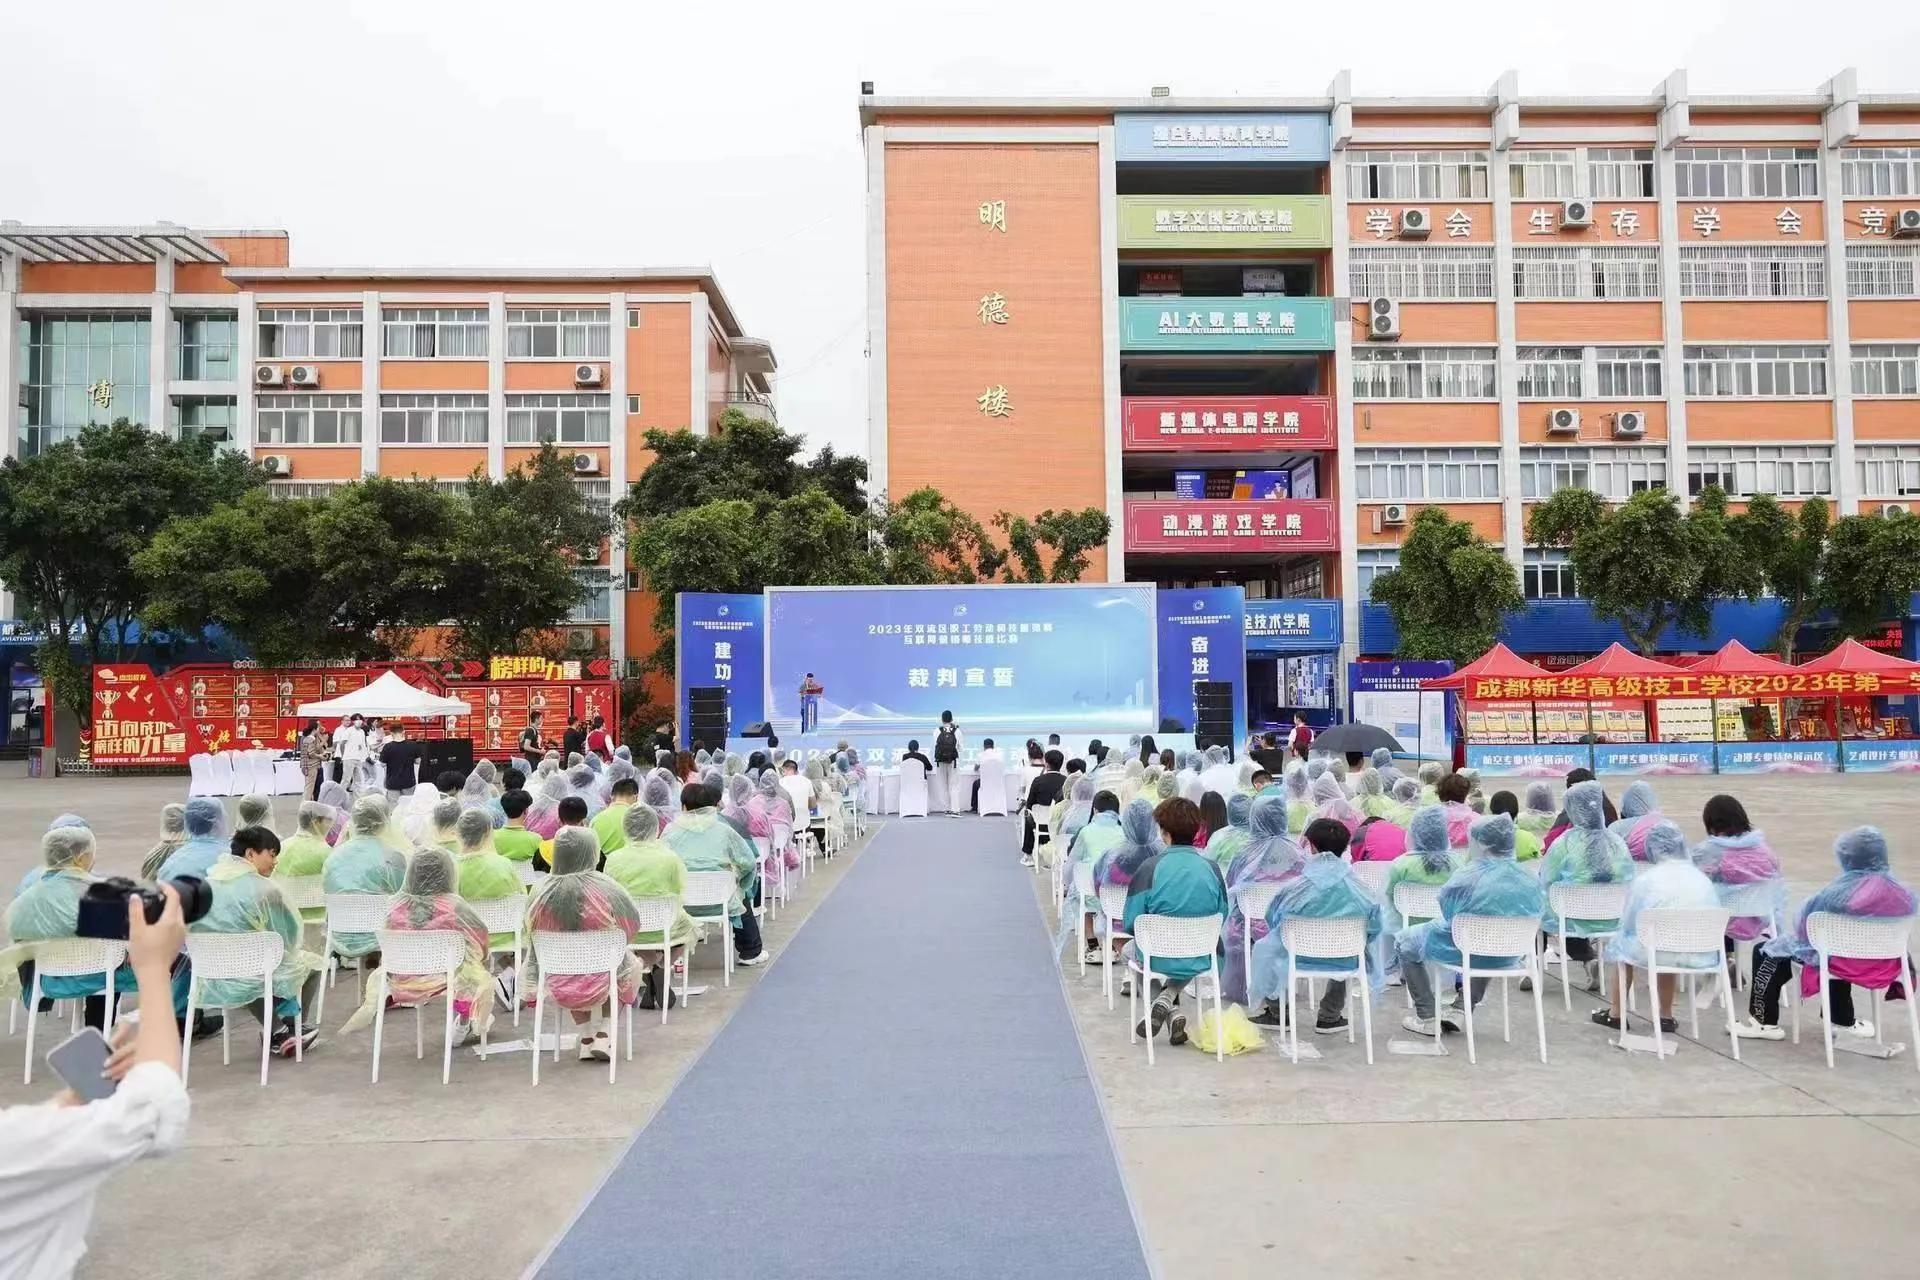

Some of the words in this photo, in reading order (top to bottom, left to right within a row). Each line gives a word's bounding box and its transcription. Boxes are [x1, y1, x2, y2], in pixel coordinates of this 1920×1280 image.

[1155, 209, 1292, 225] 数字文创艺术学院
[977, 199, 1015, 418] 明德楼
[1158, 311, 1295, 327] AI大数据学院
[1160, 412, 1299, 428] 新媒体电商学院
[1163, 514, 1302, 530] 动漫游戏学院
[490, 655, 582, 681] 榜样的力量
[908, 667, 1015, 688] 裁判宣誓
[94, 719, 167, 739] 迈向成功
[94, 732, 186, 758] 榜样的力量
[1482, 755, 1574, 765] 航空专业特色展示区
[1609, 753, 1698, 764] 护理专业特色展示区
[1733, 751, 1824, 762] 动漫专业特色展示区
